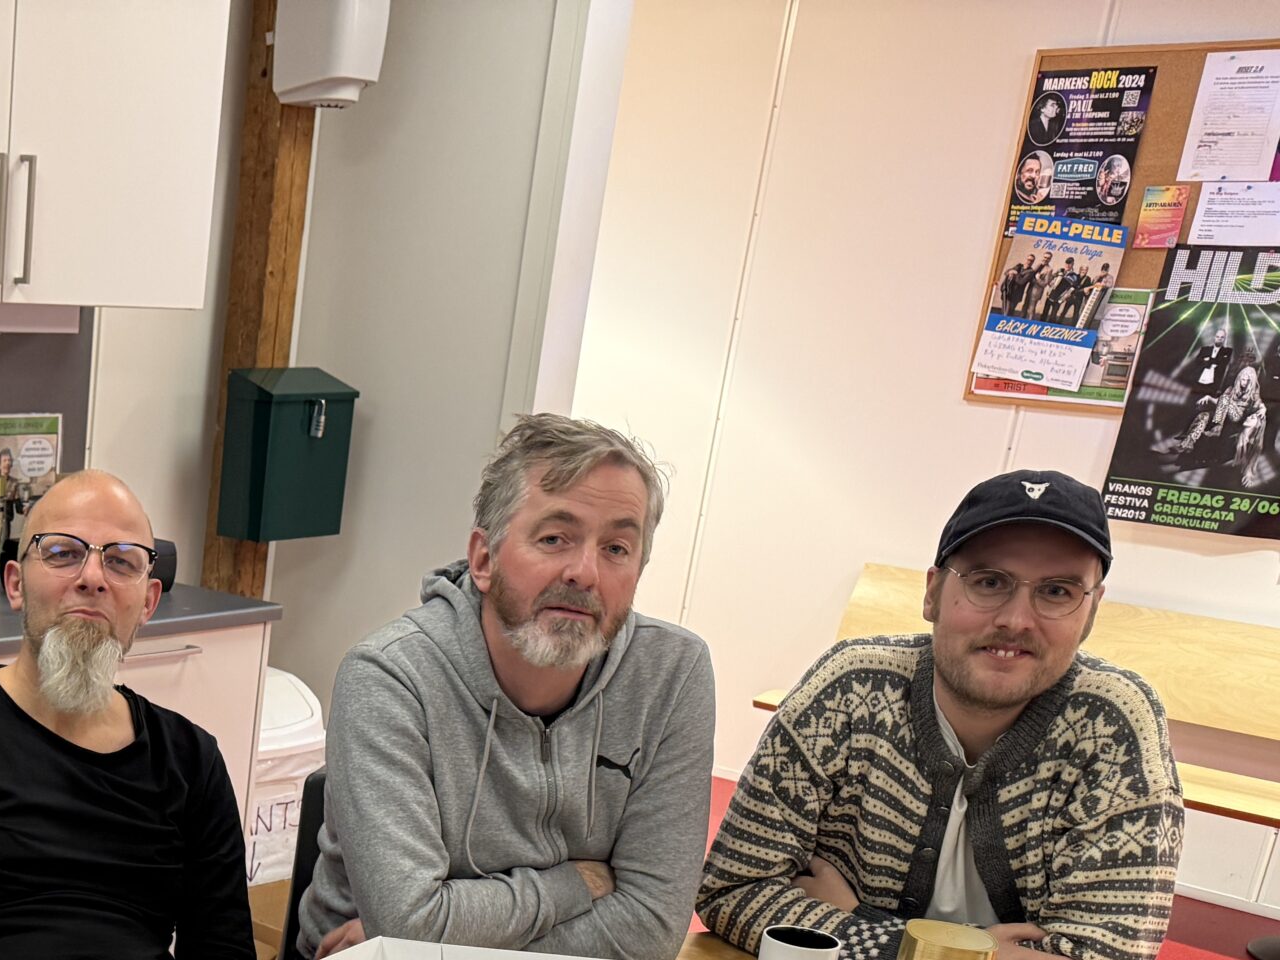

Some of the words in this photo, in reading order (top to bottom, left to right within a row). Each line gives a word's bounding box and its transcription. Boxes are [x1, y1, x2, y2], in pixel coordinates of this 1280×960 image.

[1043, 77, 1090, 90] MARKENS
[1089, 70, 1120, 88] ROCK
[1118, 74, 1145, 88] 2024
[1069, 99, 1093, 112] PAUL
[1057, 164, 1072, 172] FAT
[1073, 164, 1094, 172] FRED
[1023, 216, 1123, 243] EDA-PELLE
[1033, 240, 1041, 249] &
[1042, 239, 1057, 251] The
[1058, 242, 1078, 255] Four
[1027, 322, 1041, 337] IN
[1040, 326, 1088, 342] BIZZNIZZ
[1003, 382, 1027, 391] TRIST
[1108, 482, 1153, 496] VRANGS
[1104, 494, 1149, 508] FESTIVA
[1156, 488, 1225, 508] FREDAG
[1229, 497, 1280, 515] 28/06
[1153, 502, 1235, 522] GRENSEGATA
[1150, 513, 1219, 530] MOROKULIEN
